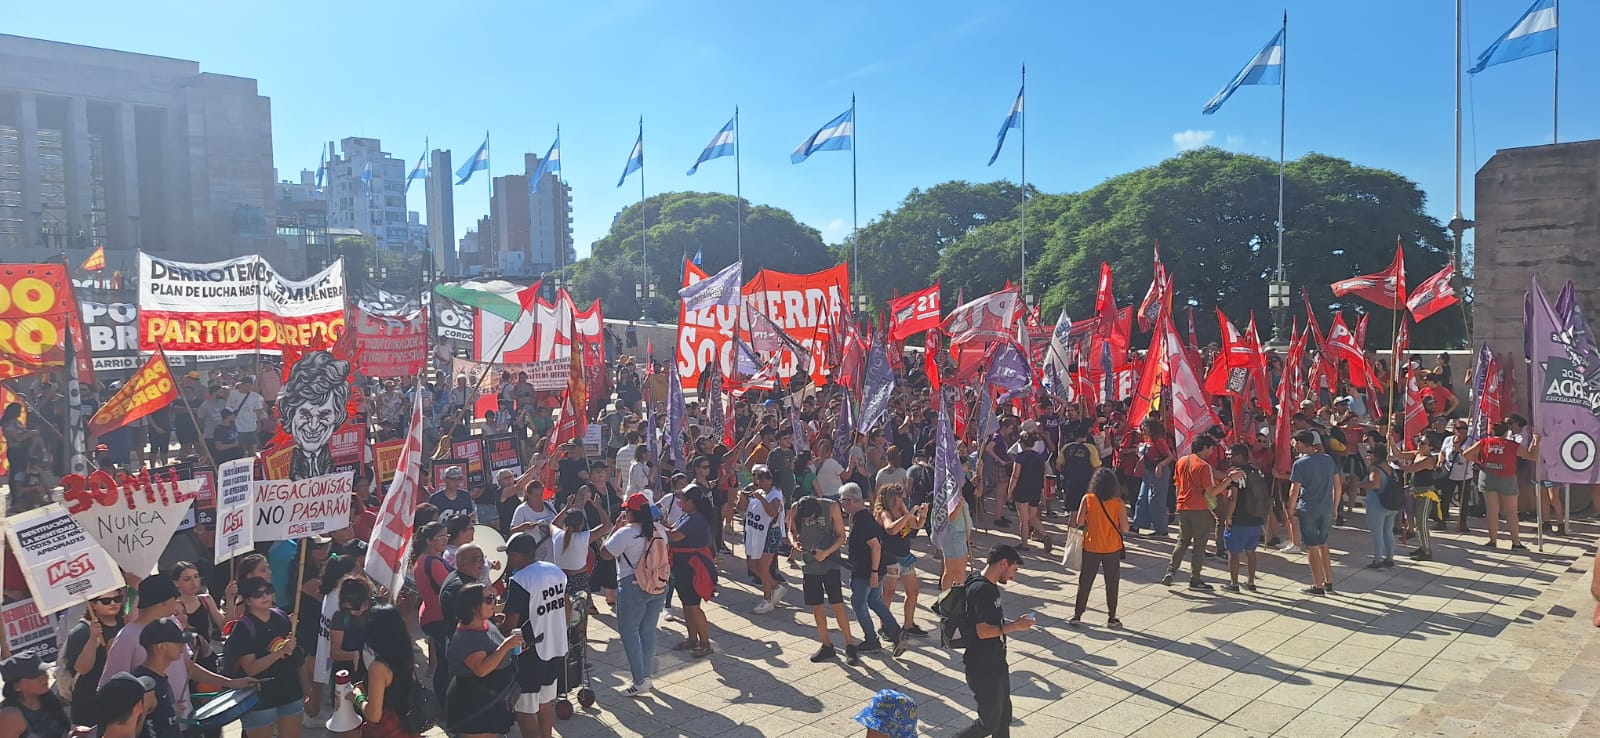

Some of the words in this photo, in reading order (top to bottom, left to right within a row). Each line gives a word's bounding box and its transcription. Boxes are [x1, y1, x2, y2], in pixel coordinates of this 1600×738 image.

[151, 283, 183, 296] PLAN
[186, 285, 200, 298] DE
[202, 285, 237, 298] LUCHA
[148, 318, 257, 344] PARTIDO
[754, 331, 768, 339] PTS
[1488, 445, 1505, 455] PTS
[61, 470, 118, 515] 30
[119, 466, 200, 510] MIL
[256, 505, 285, 526] NO
[289, 495, 348, 522] PASARÁN
[96, 510, 166, 538] NUNCA
[117, 528, 155, 554] MÁS
[48, 554, 95, 584] MST
